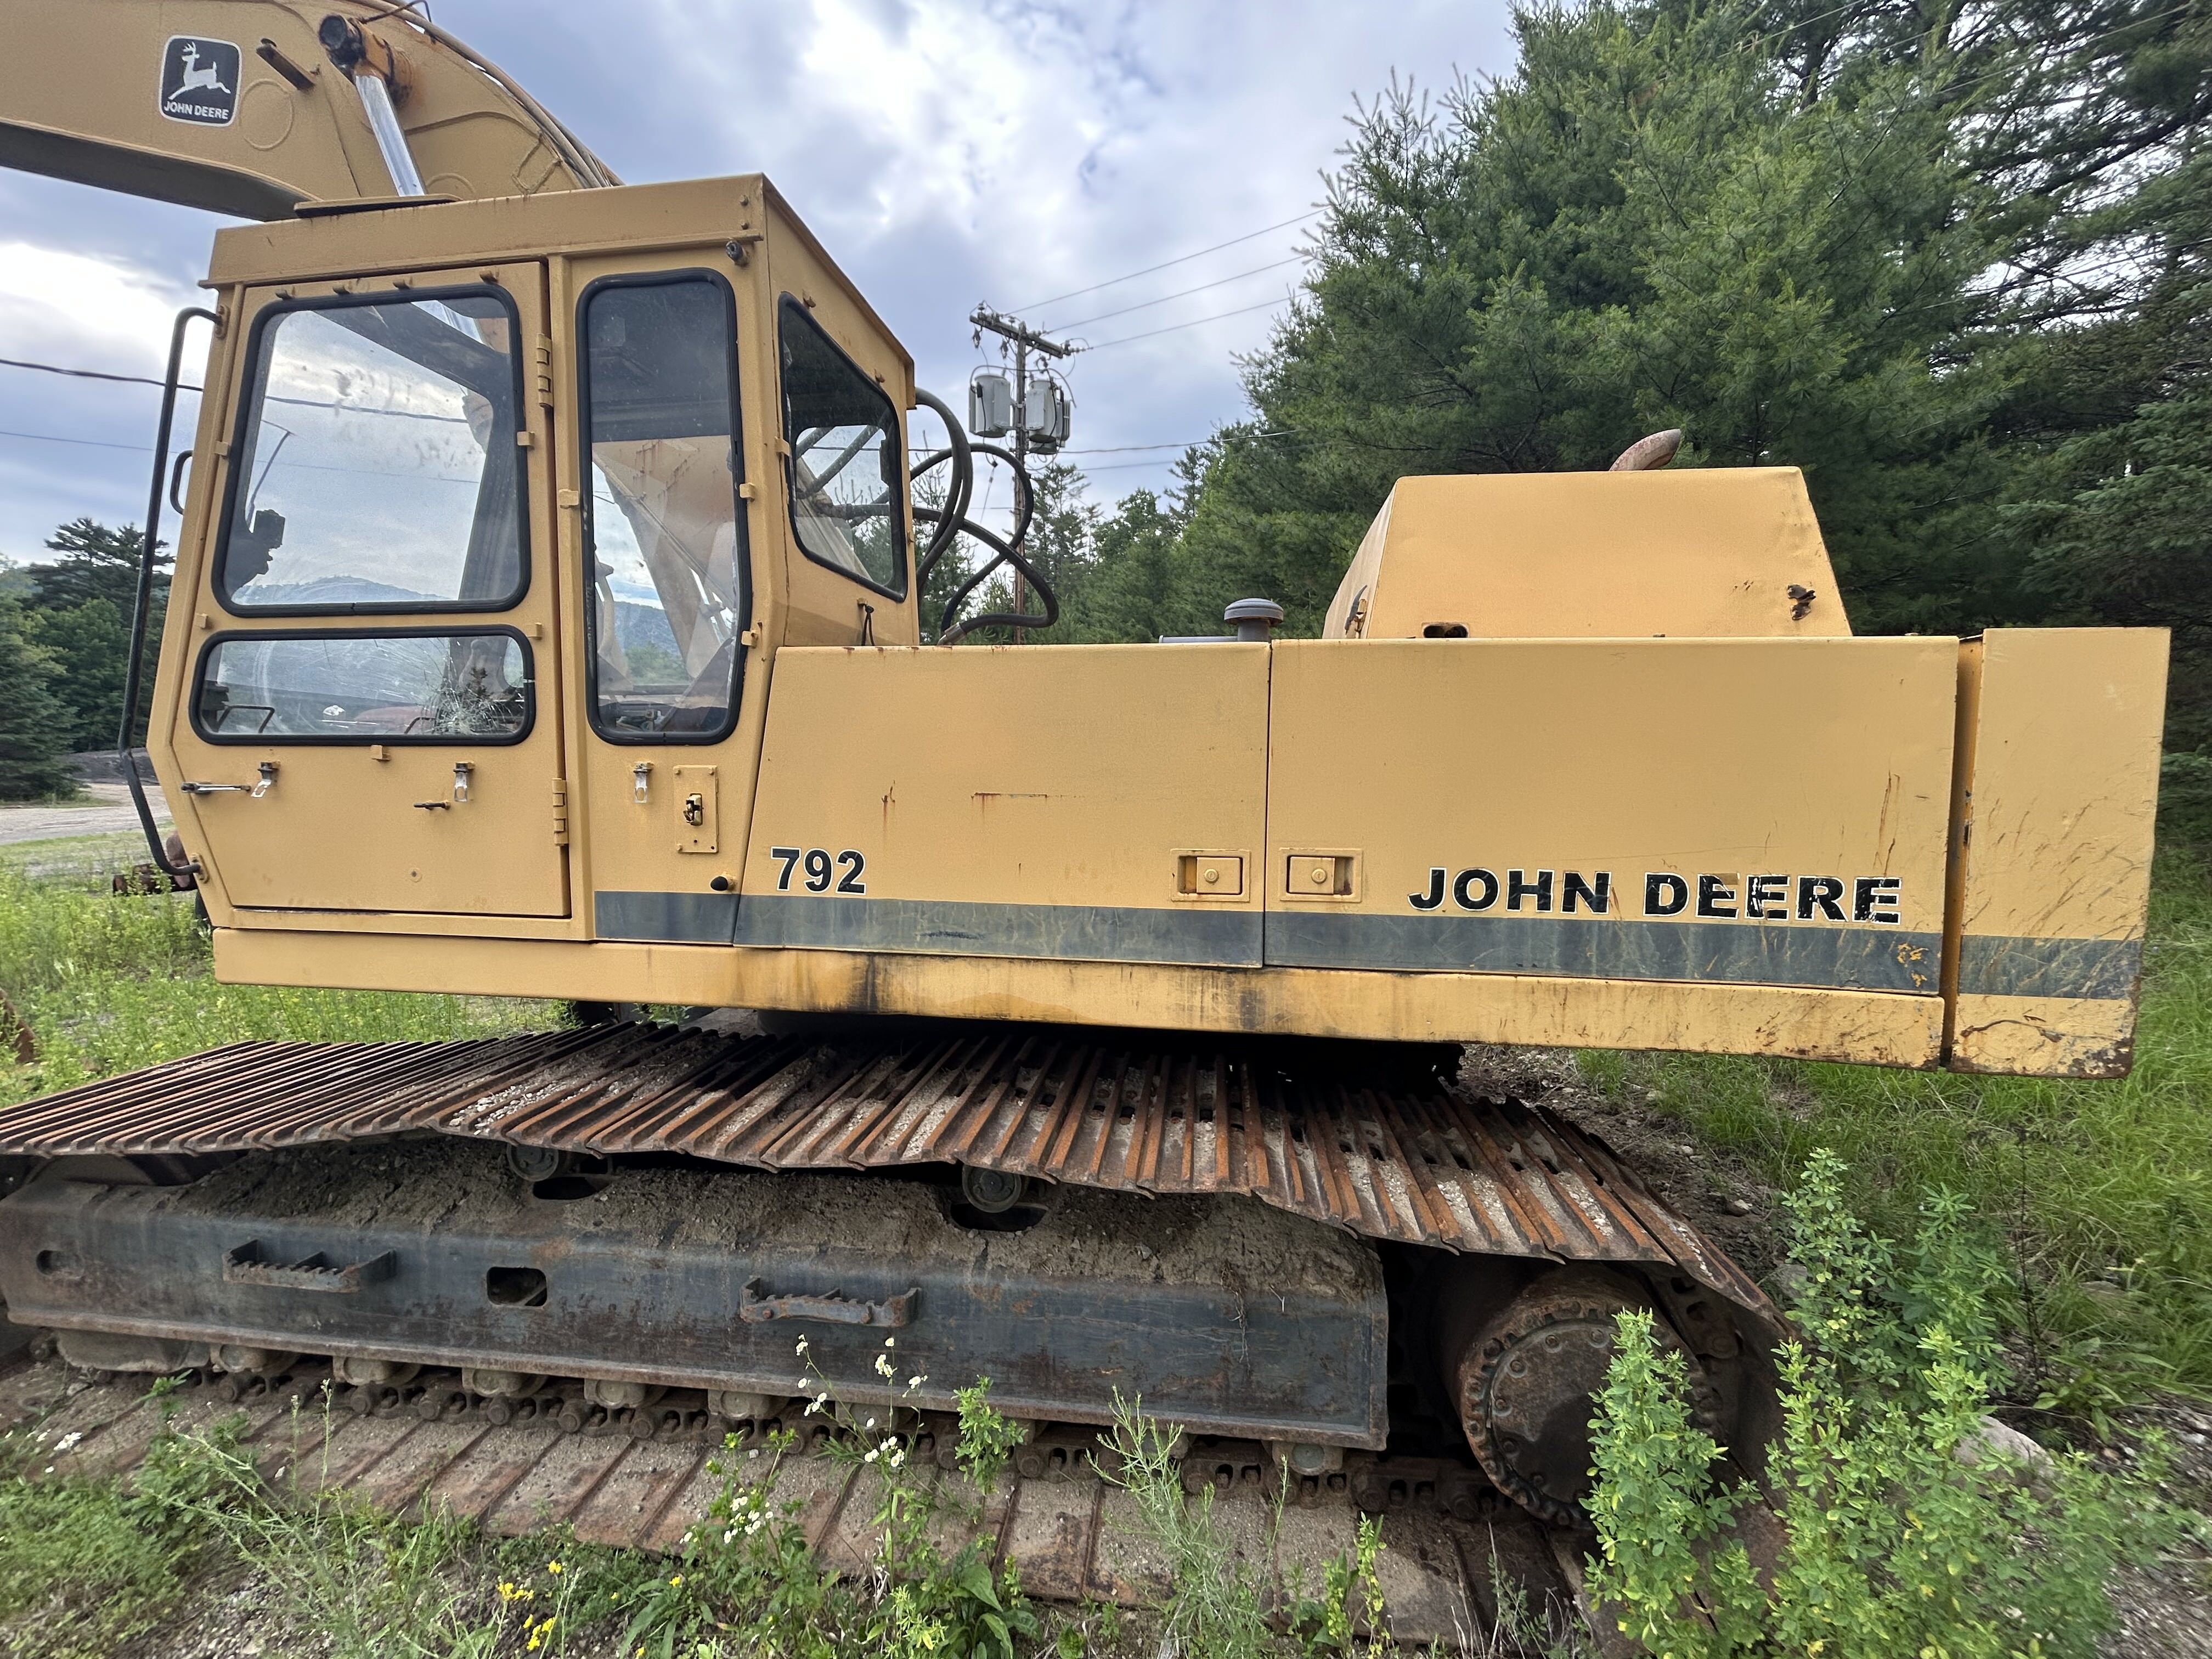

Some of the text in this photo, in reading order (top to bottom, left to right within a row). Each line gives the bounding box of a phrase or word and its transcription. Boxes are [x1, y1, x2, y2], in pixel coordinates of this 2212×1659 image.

[164, 100, 229, 119] JOHN DEERE
[771, 846, 866, 895] 792
[1407, 867, 1901, 925] JOHN DEERE
